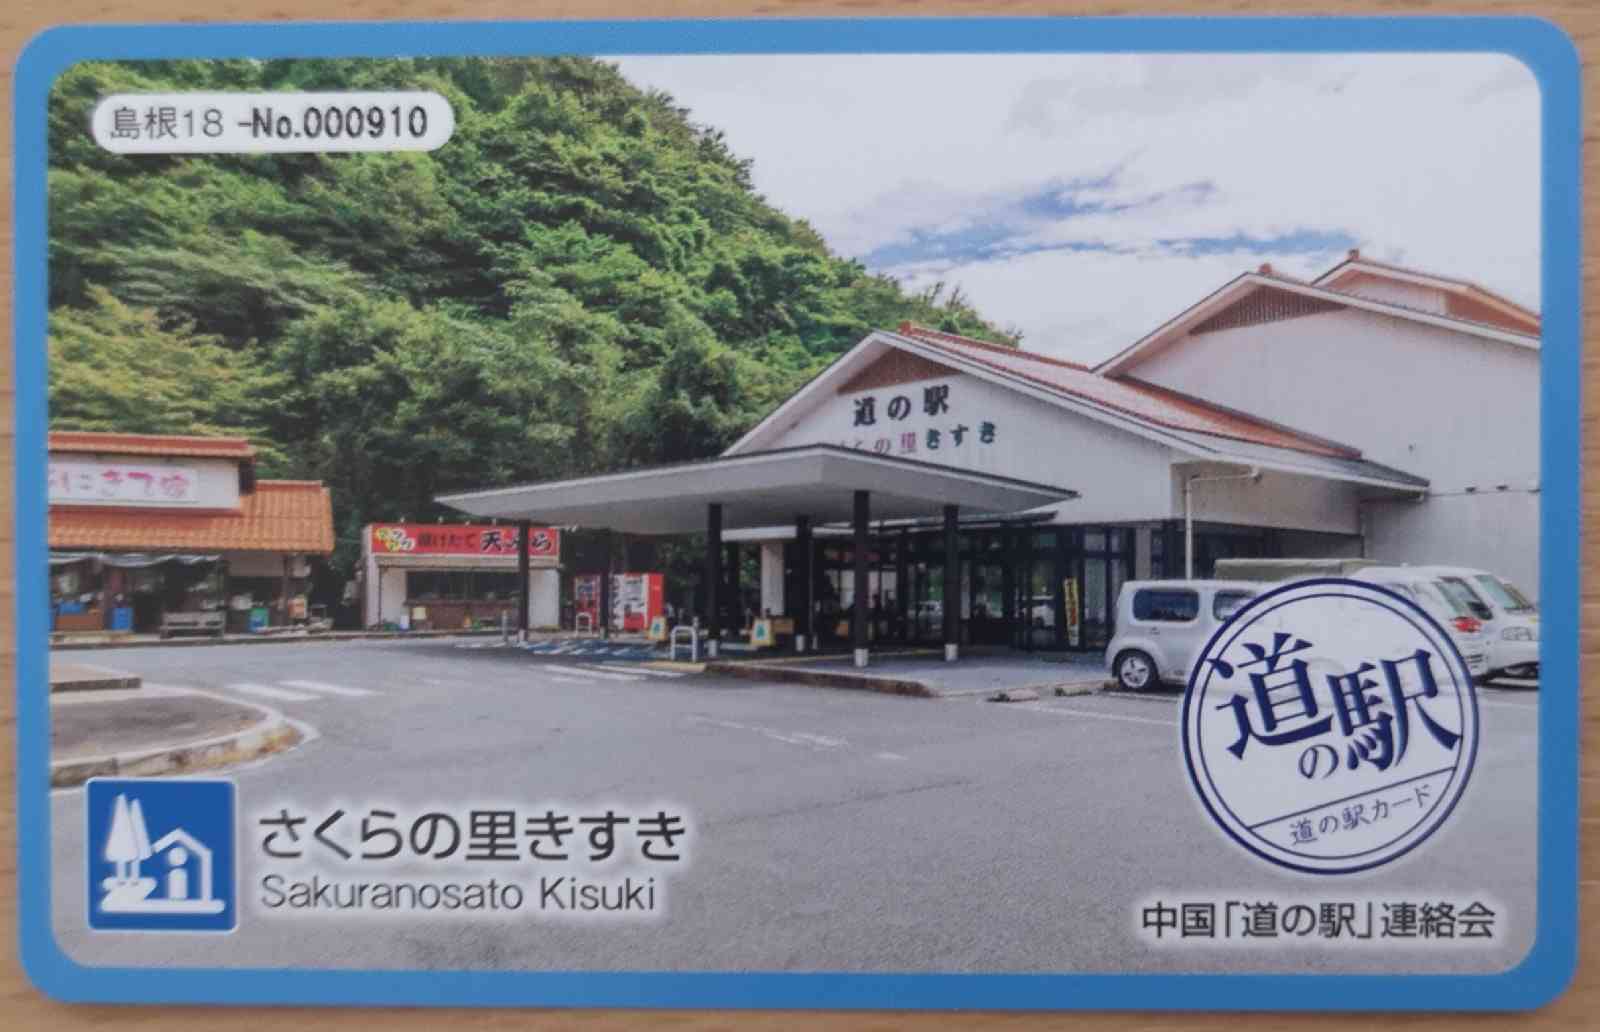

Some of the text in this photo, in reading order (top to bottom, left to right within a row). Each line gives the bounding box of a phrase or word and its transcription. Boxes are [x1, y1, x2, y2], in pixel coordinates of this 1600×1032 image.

[109, 106, 225, 140] 島根18
[853, 384, 949, 427] 道の駅
[1207, 632, 1463, 780] 道の駅
[259, 808, 687, 862] さくらの里きすき
[1289, 784, 1432, 846] 道の駅カード
[261, 874, 657, 912] Sakuranosato Kisuki
[1141, 900, 1496, 940] 中国「道の駅」連絡会
